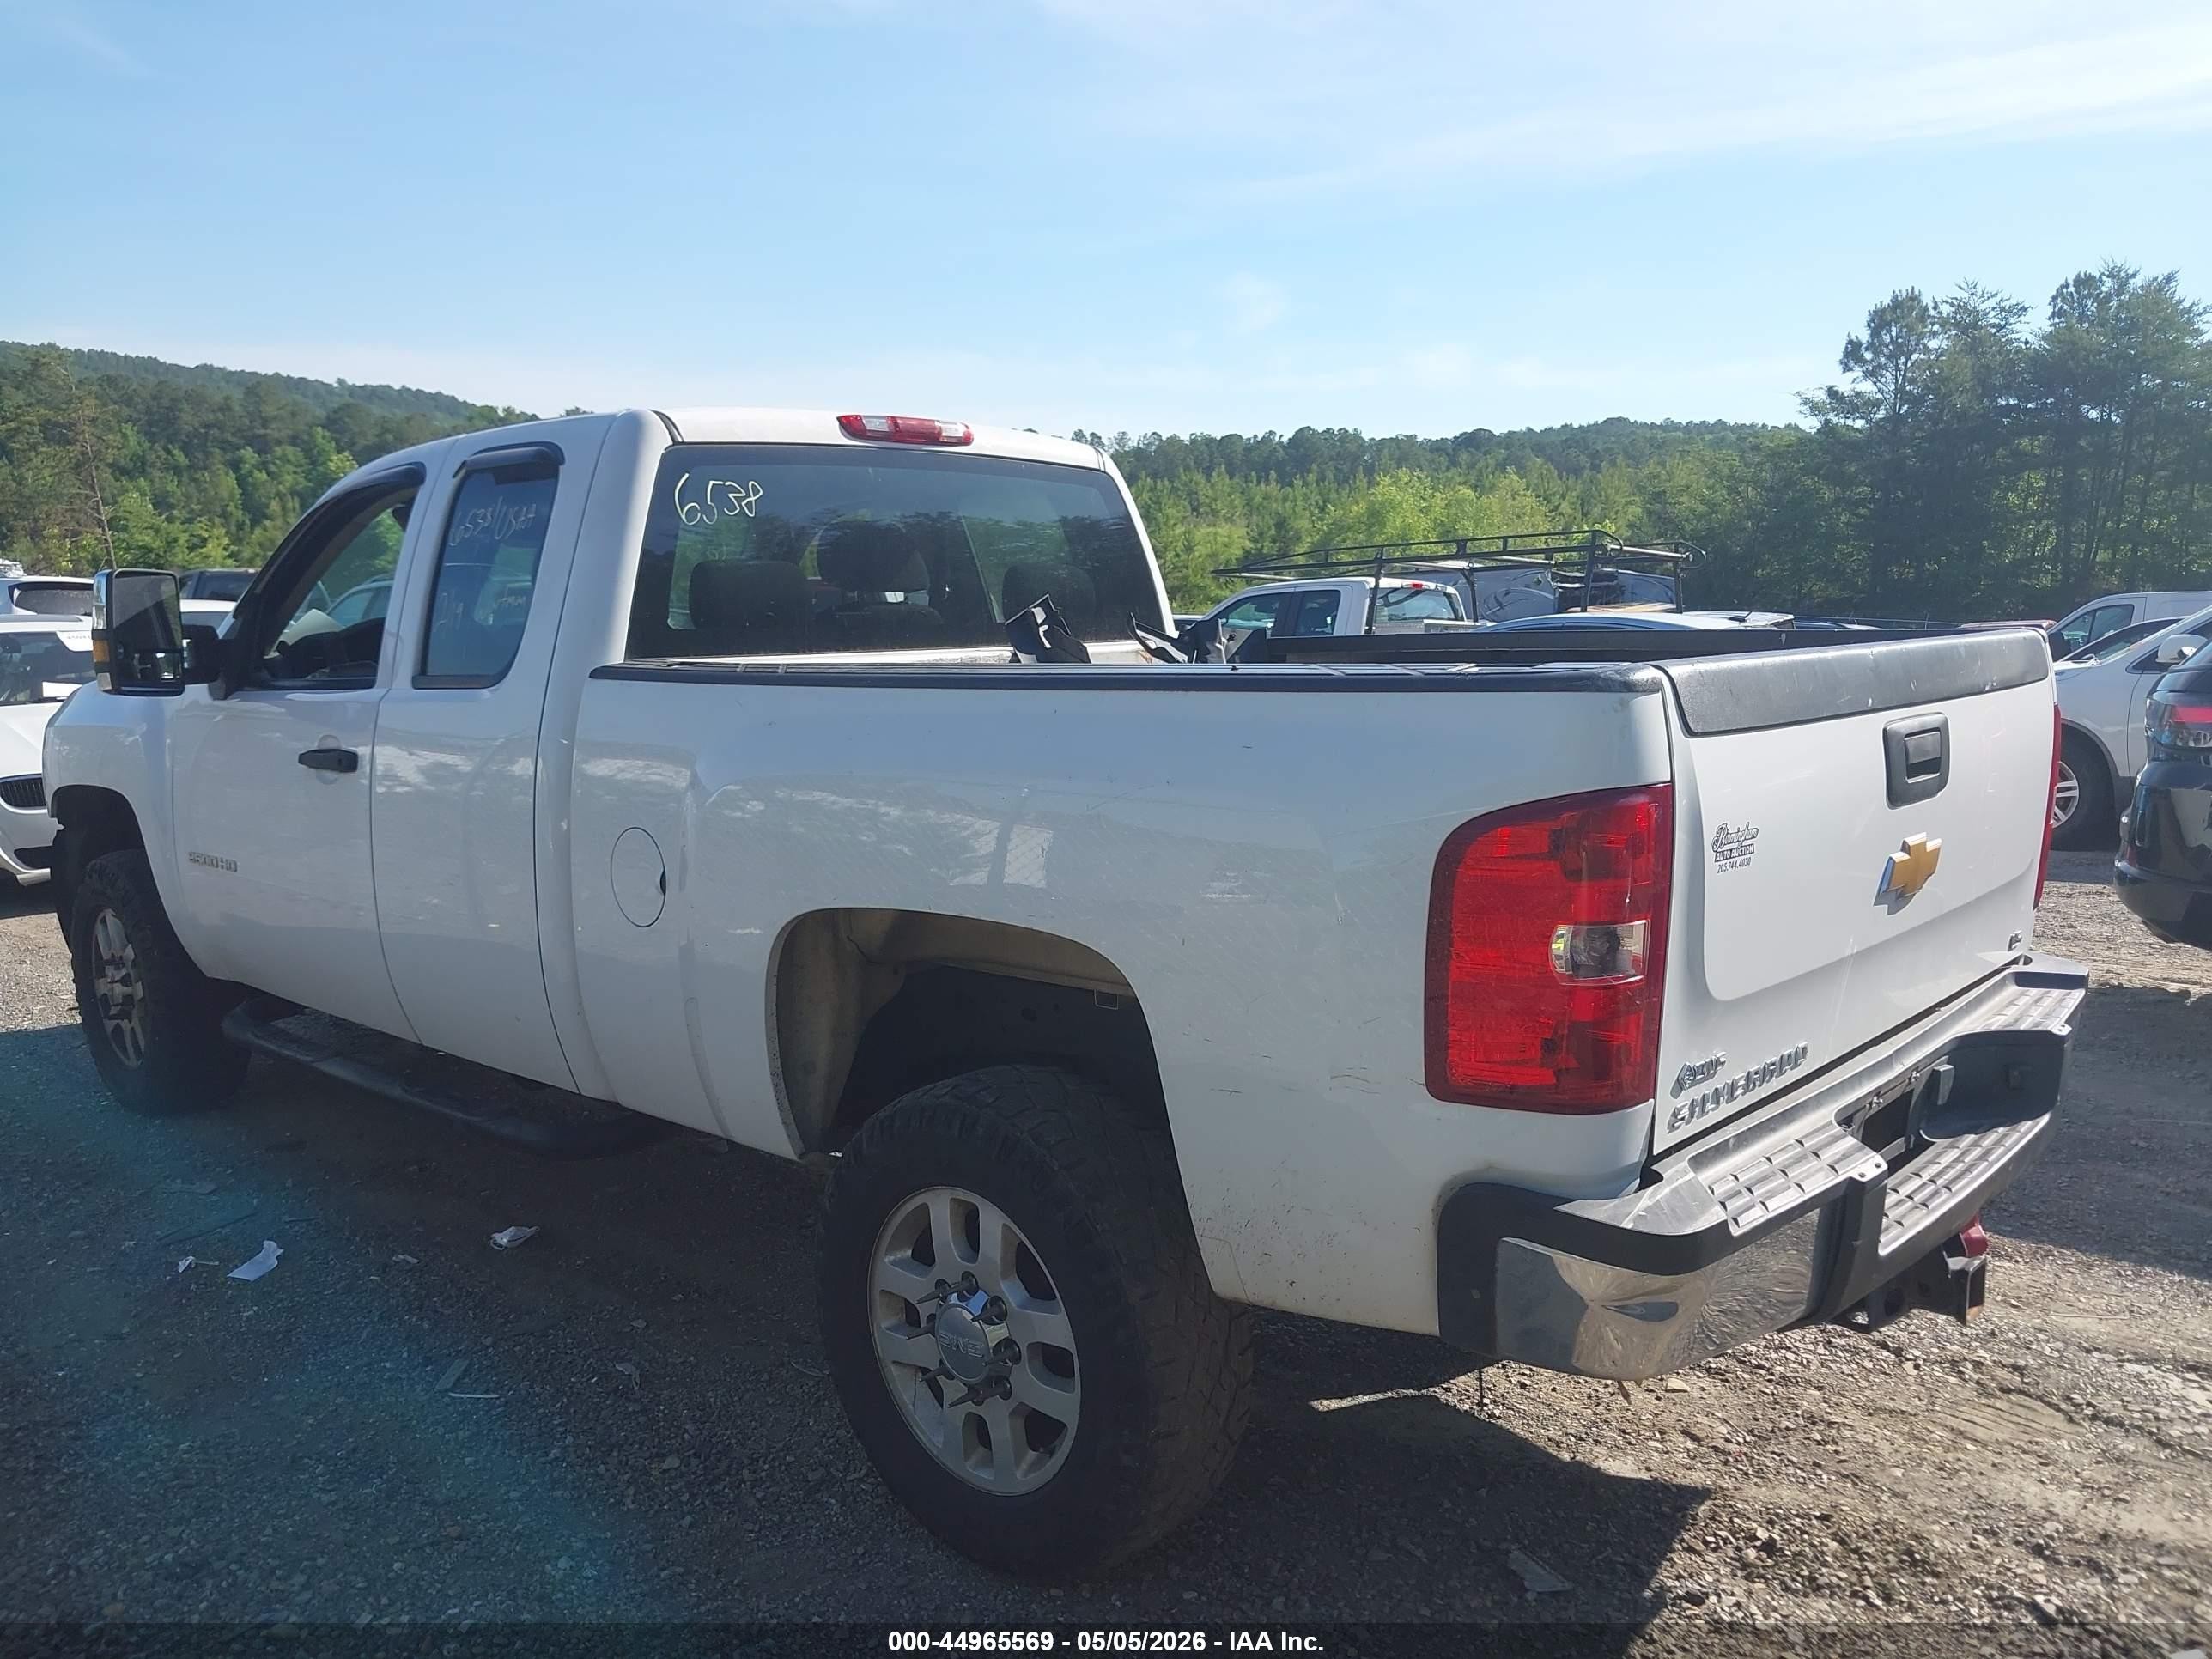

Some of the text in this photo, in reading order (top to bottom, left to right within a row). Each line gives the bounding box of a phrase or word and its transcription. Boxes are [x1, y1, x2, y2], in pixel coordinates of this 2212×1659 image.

[674, 472, 763, 526] 6538
[1711, 821, 1759, 853] Birmingham
[1717, 844, 1754, 861] AUTO AUCTION
